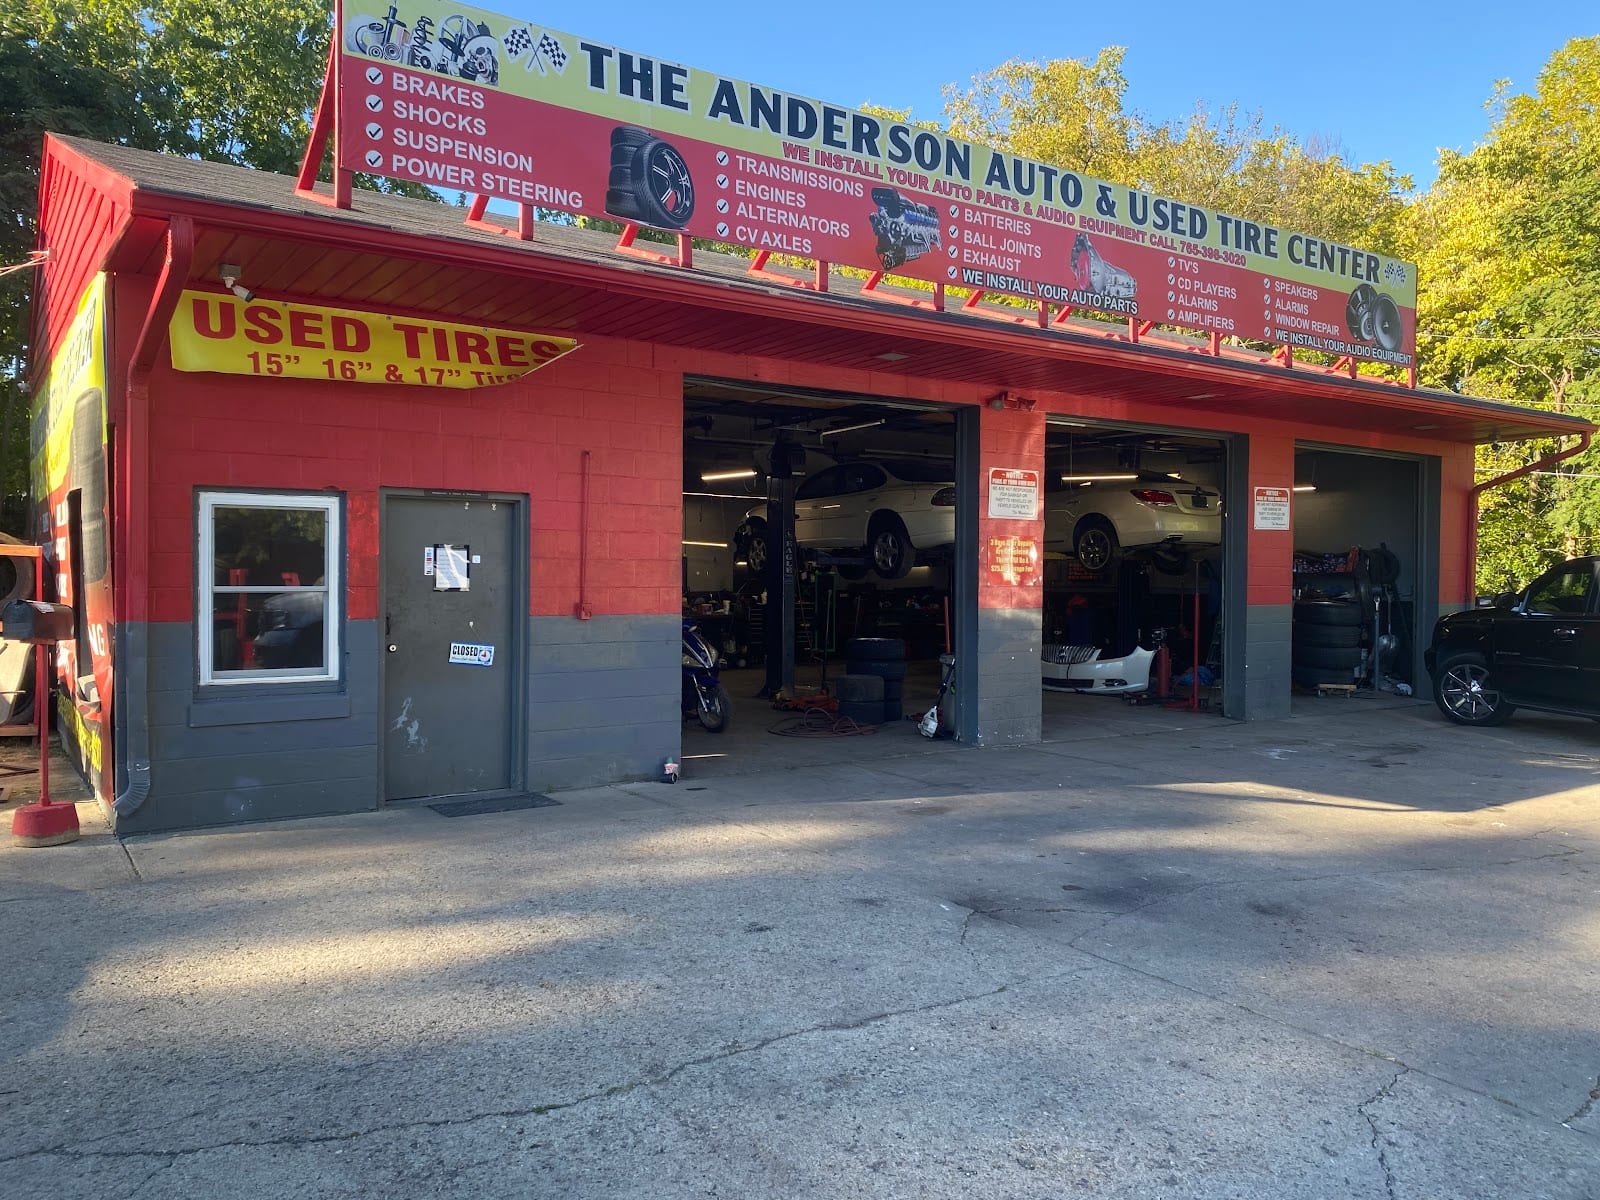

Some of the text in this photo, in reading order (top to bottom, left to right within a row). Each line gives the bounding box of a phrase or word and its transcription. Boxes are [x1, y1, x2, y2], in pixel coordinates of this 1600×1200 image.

[392, 72, 485, 110] BRAKES
[393, 100, 487, 136] SHOCKS
[393, 127, 533, 173] SUSPENSION
[579, 42, 1380, 283] THE ANDERSON AUTO & USED TIRE CENTER
[392, 154, 583, 209] POWER STEERING
[735, 155, 864, 197] TRANSMISSIONS
[735, 180, 806, 208] ENGINES
[782, 141, 810, 163] WE
[814, 148, 884, 180] INSTALL
[886, 166, 929, 193] YOUR
[932, 181, 973, 202] AUTO
[976, 190, 1019, 212] PARTS
[1023, 202, 1033, 216] &
[1036, 206, 1076, 226] AUDIO
[1079, 215, 1148, 243] EQUIPMENT
[1150, 233, 1178, 252] CALL
[736, 202, 850, 238] ALTERNATORS
[964, 208, 1031, 236] BATTERIES
[735, 226, 812, 254] CV AXLES
[963, 230, 1042, 259] BALL JOINTS
[963, 249, 1021, 272] EXHAUST
[1178, 258, 1199, 274] TV'S
[962, 269, 1138, 314] WE INSTALL YOUR AUTO PARTS
[1177, 278, 1237, 300] CD PLAYERS
[1178, 293, 1218, 312] ALARMS
[1274, 281, 1318, 300] SPEAKERS
[1177, 310, 1235, 330] AMPLIFIERS
[1275, 298, 1309, 315] ALARMS
[191, 299, 561, 367] USED TIRES
[1275, 313, 1340, 336] WINDOW REPAIR
[1275, 329, 1412, 365] WE INSTALL YOUR AUDIO EQUIPMENT
[384, 364, 405, 384] &
[452, 645, 479, 657] CLOSED
